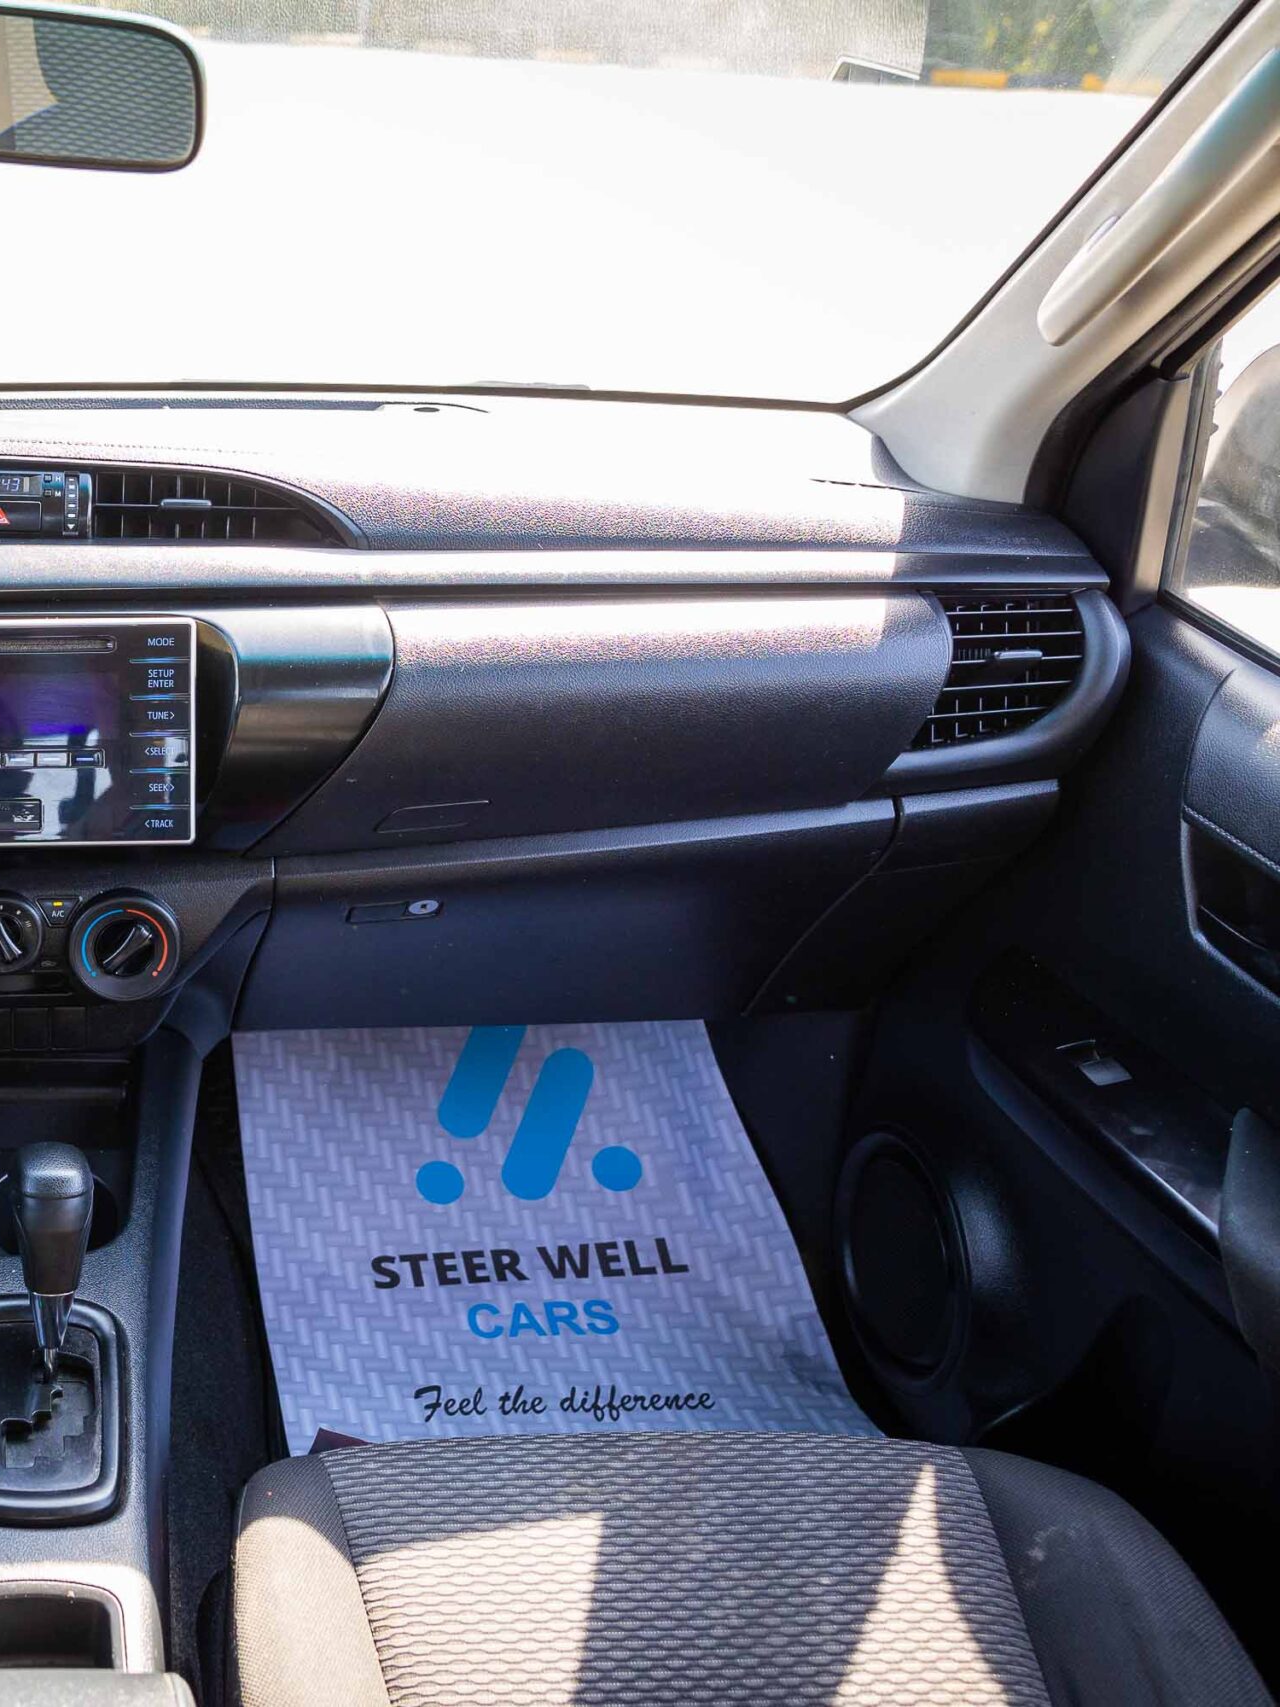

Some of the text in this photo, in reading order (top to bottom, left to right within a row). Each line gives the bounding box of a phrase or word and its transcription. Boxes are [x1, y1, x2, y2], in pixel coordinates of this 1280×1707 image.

[147, 637, 175, 646] MODE
[148, 669, 175, 678] SETUP
[147, 679, 174, 688] ENTER
[51, 910, 65, 918] A/C
[371, 1237, 690, 1289] STEER WELL
[467, 1299, 620, 1339] CARS
[413, 1384, 716, 1422] Feel the difference
